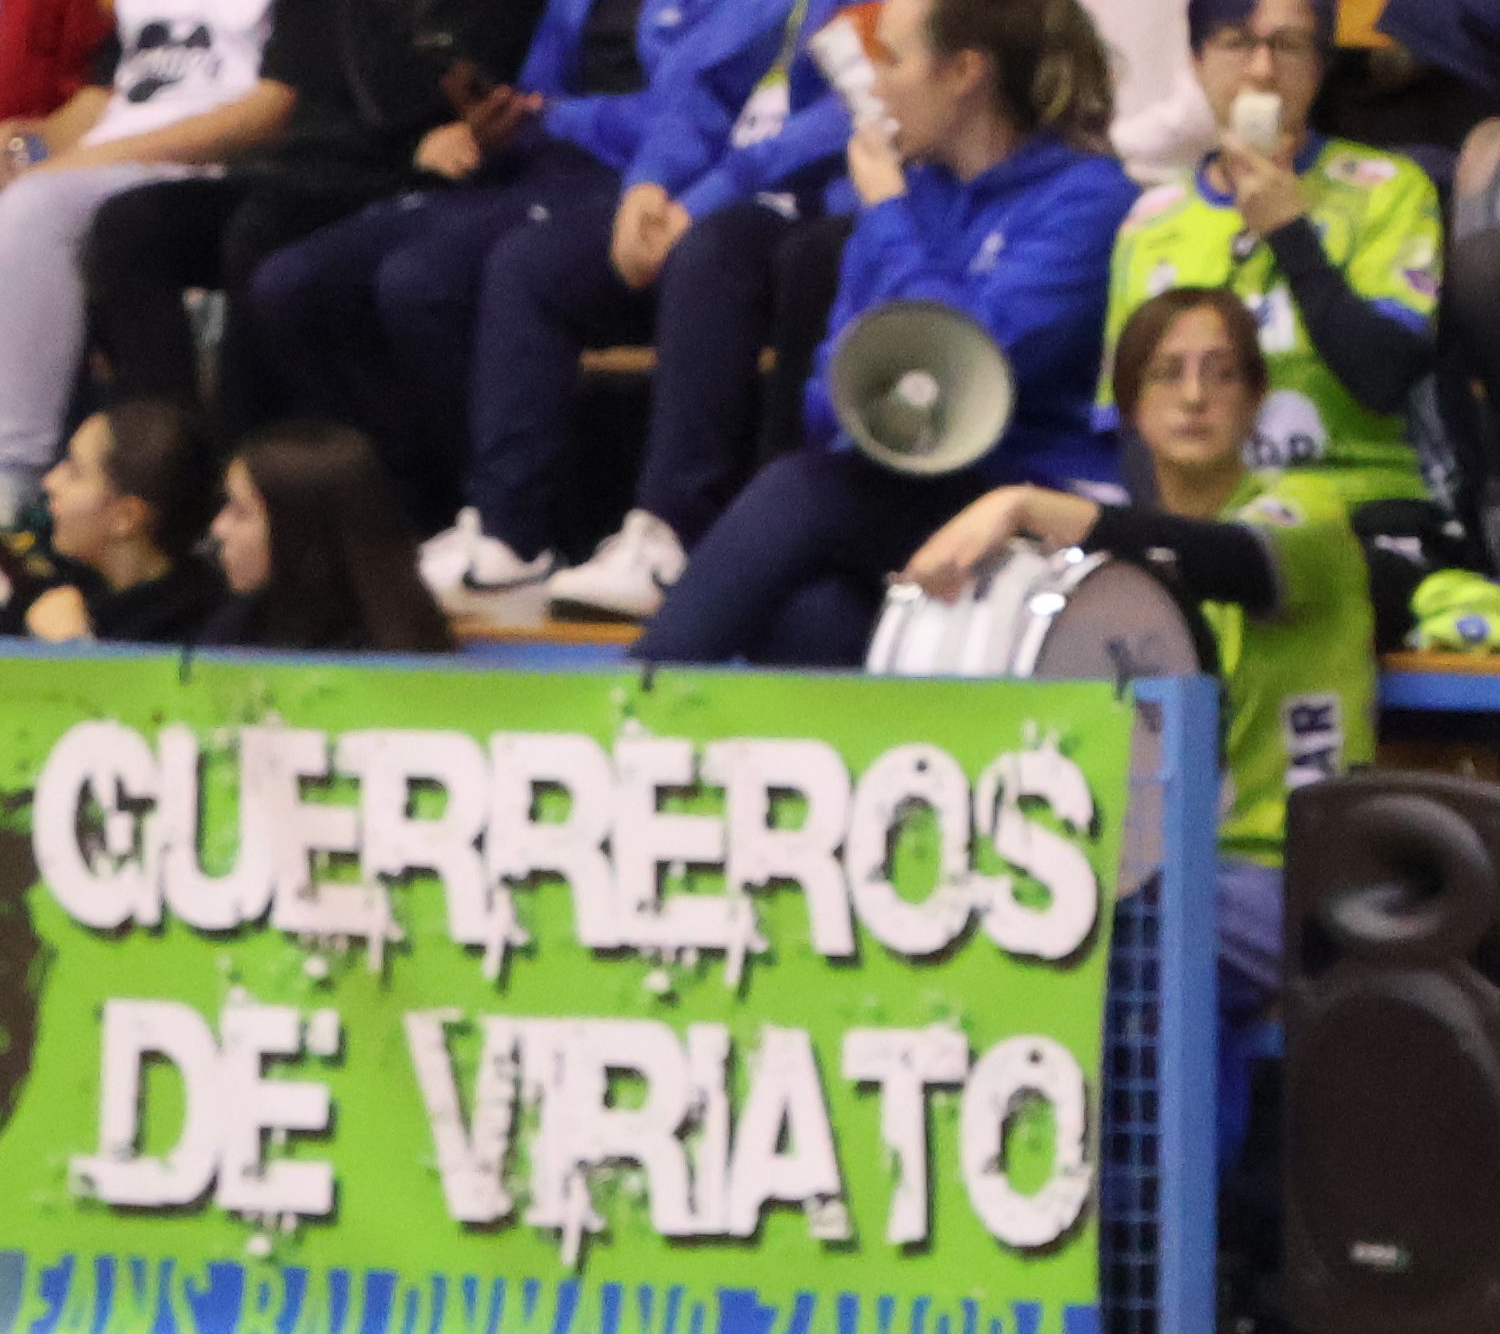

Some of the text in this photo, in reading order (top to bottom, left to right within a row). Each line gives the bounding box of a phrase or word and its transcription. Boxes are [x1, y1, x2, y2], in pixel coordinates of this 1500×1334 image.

[30, 715, 1102, 979] GUERREROS
[70, 997, 1096, 1255] DE VIRIATO
